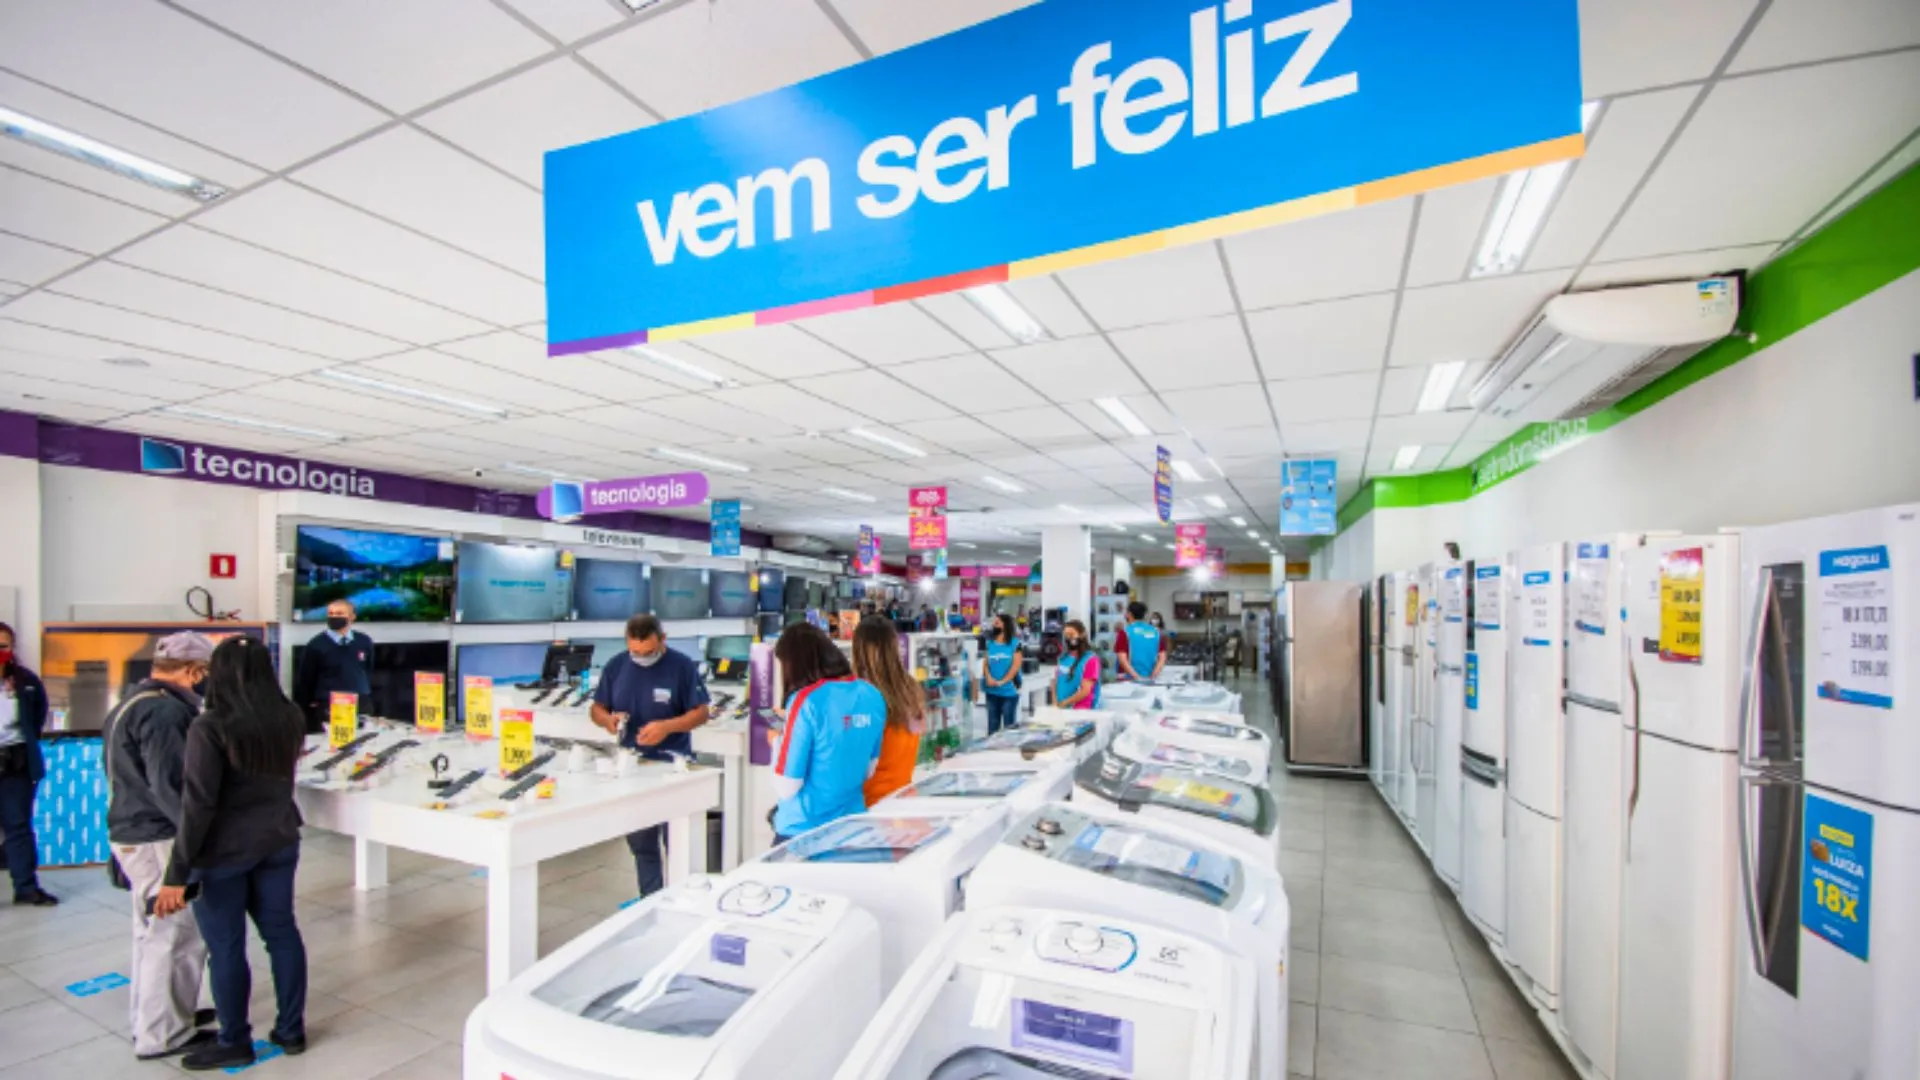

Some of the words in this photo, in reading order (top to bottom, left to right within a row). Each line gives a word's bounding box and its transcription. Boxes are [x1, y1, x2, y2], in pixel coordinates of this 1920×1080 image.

[637, 157, 831, 267] vem
[856, 94, 1037, 219] ser
[1057, 0, 1359, 170] feliz
[191, 447, 375, 497] tecnologia
[591, 478, 687, 506] tecnologia
